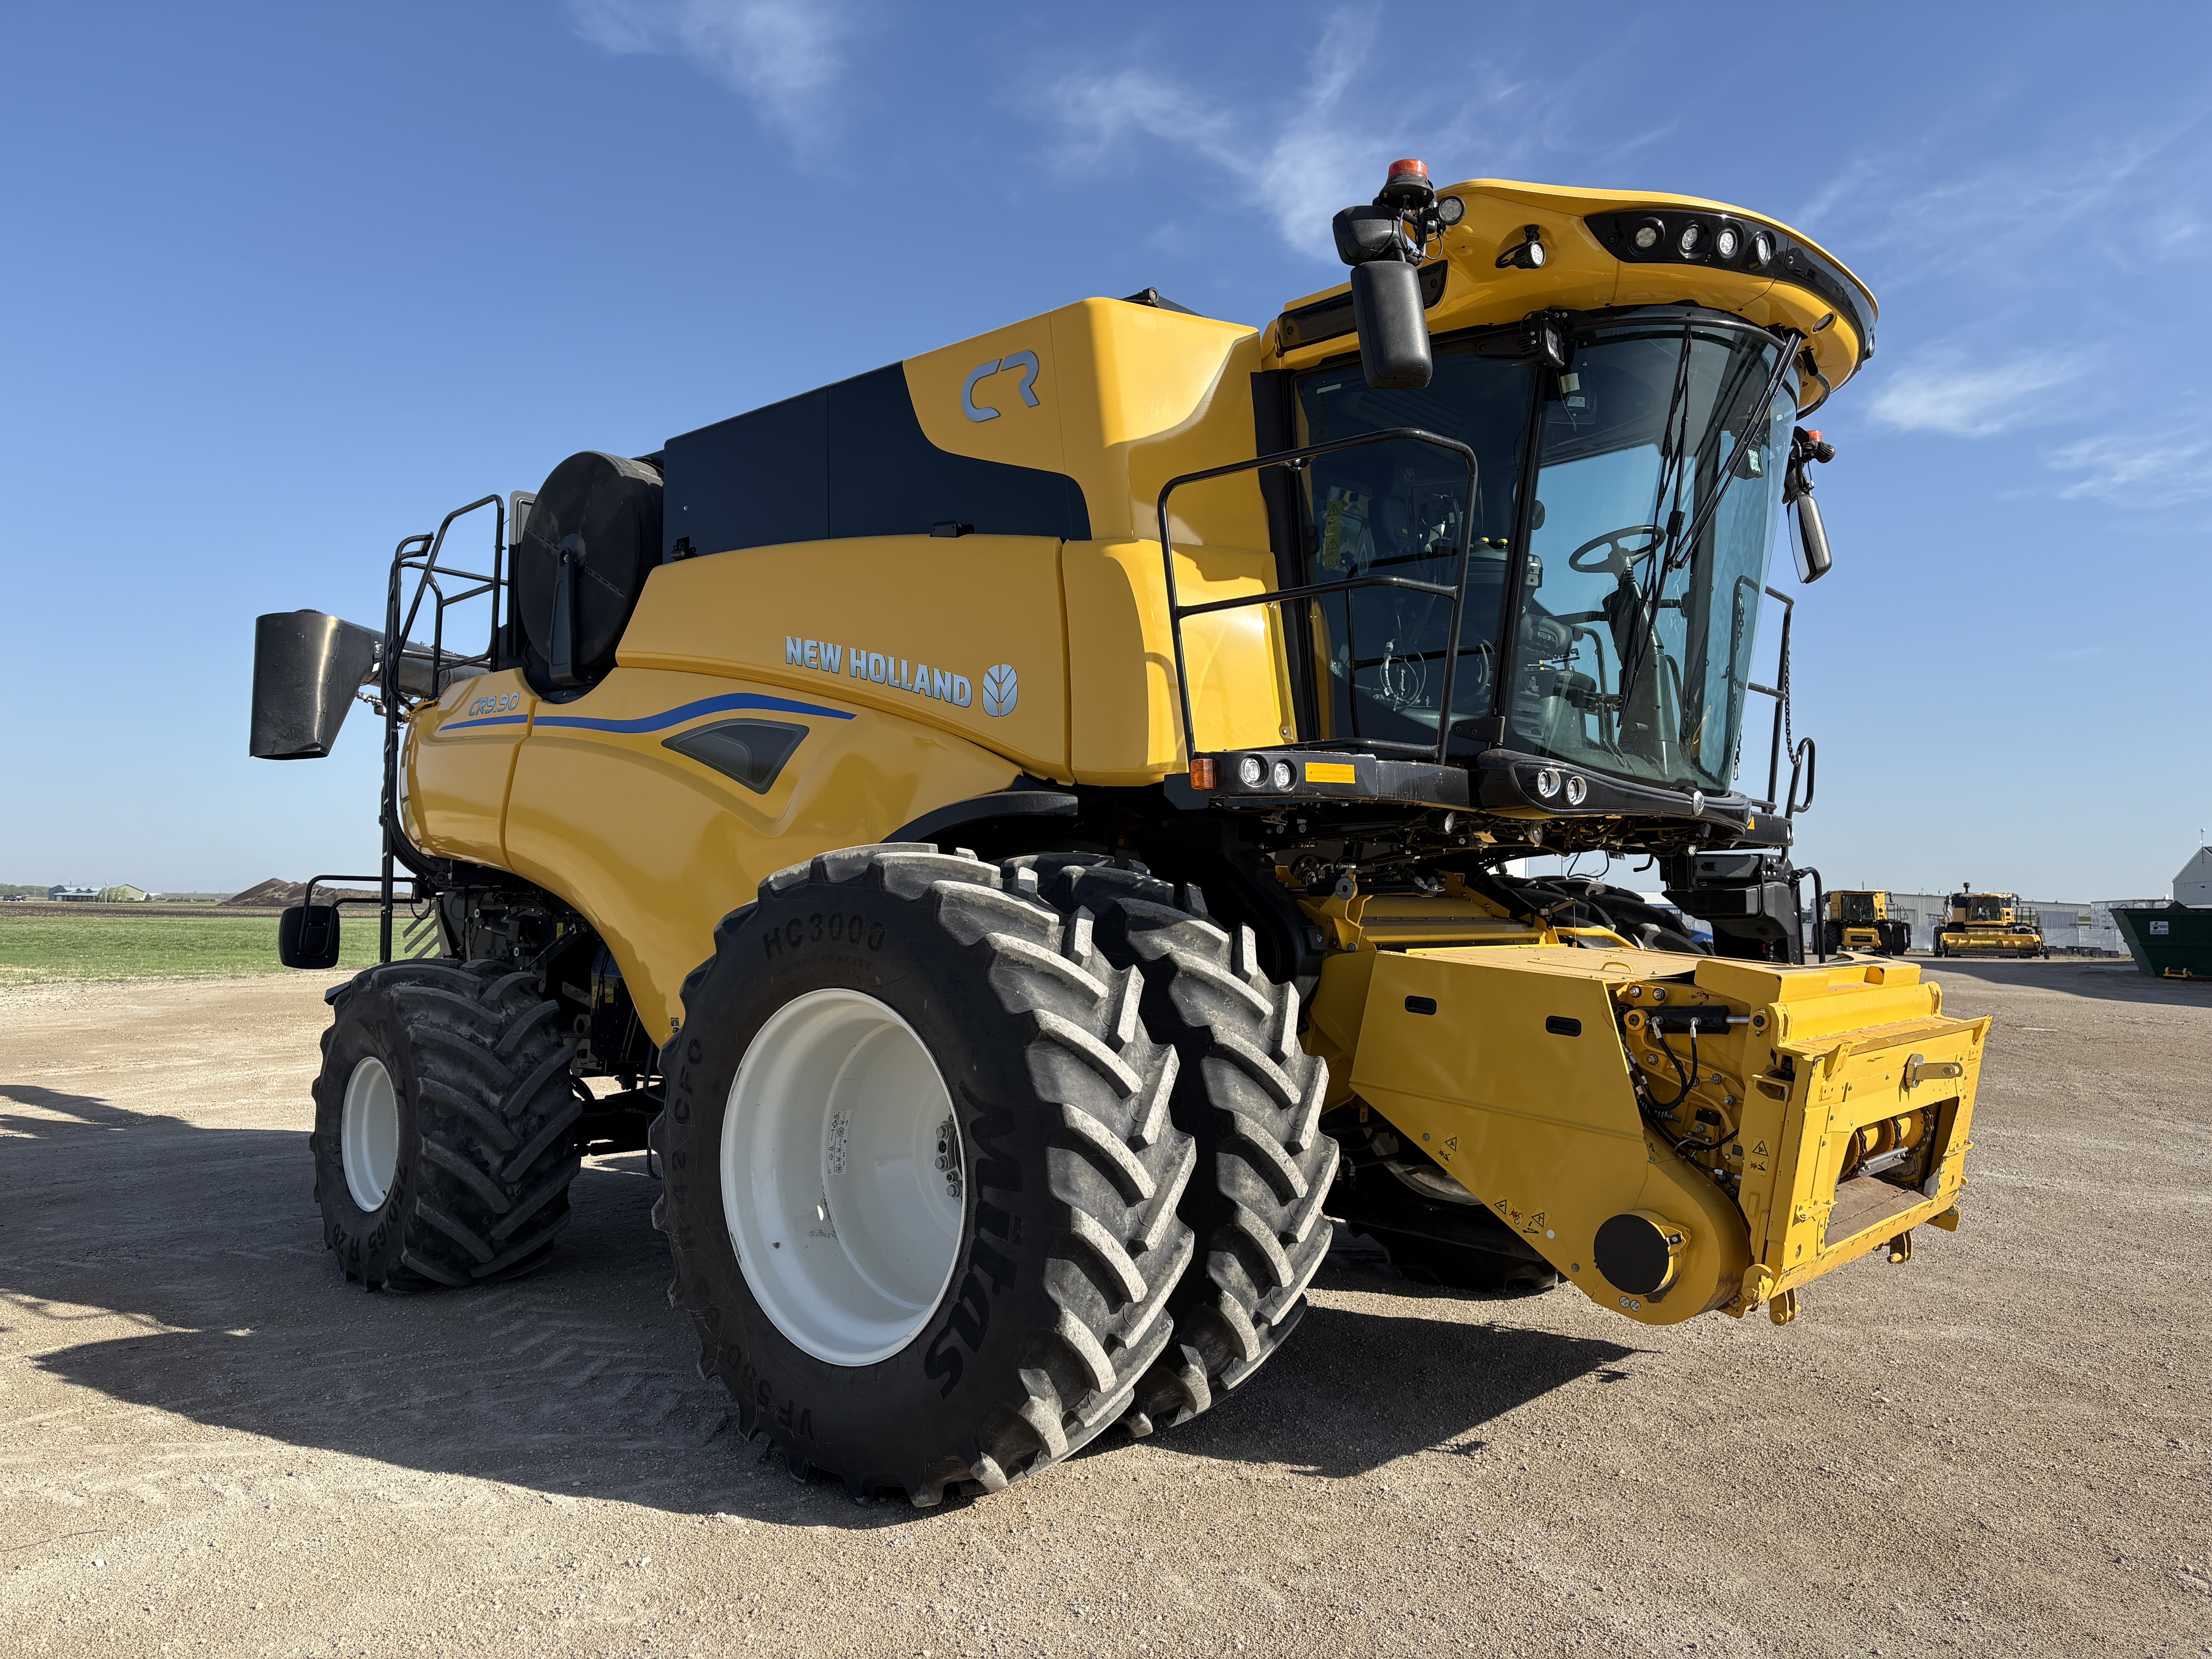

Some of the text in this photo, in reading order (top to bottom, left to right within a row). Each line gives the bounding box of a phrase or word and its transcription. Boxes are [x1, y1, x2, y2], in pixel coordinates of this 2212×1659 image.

[961, 350, 1040, 422] CR
[469, 692, 520, 716] CR9.90
[785, 636, 972, 708] NEW HOLLAND
[763, 912, 887, 961] HC3000
[673, 1038, 703, 1122] CFO
[924, 1079, 1023, 1401] Mitas
